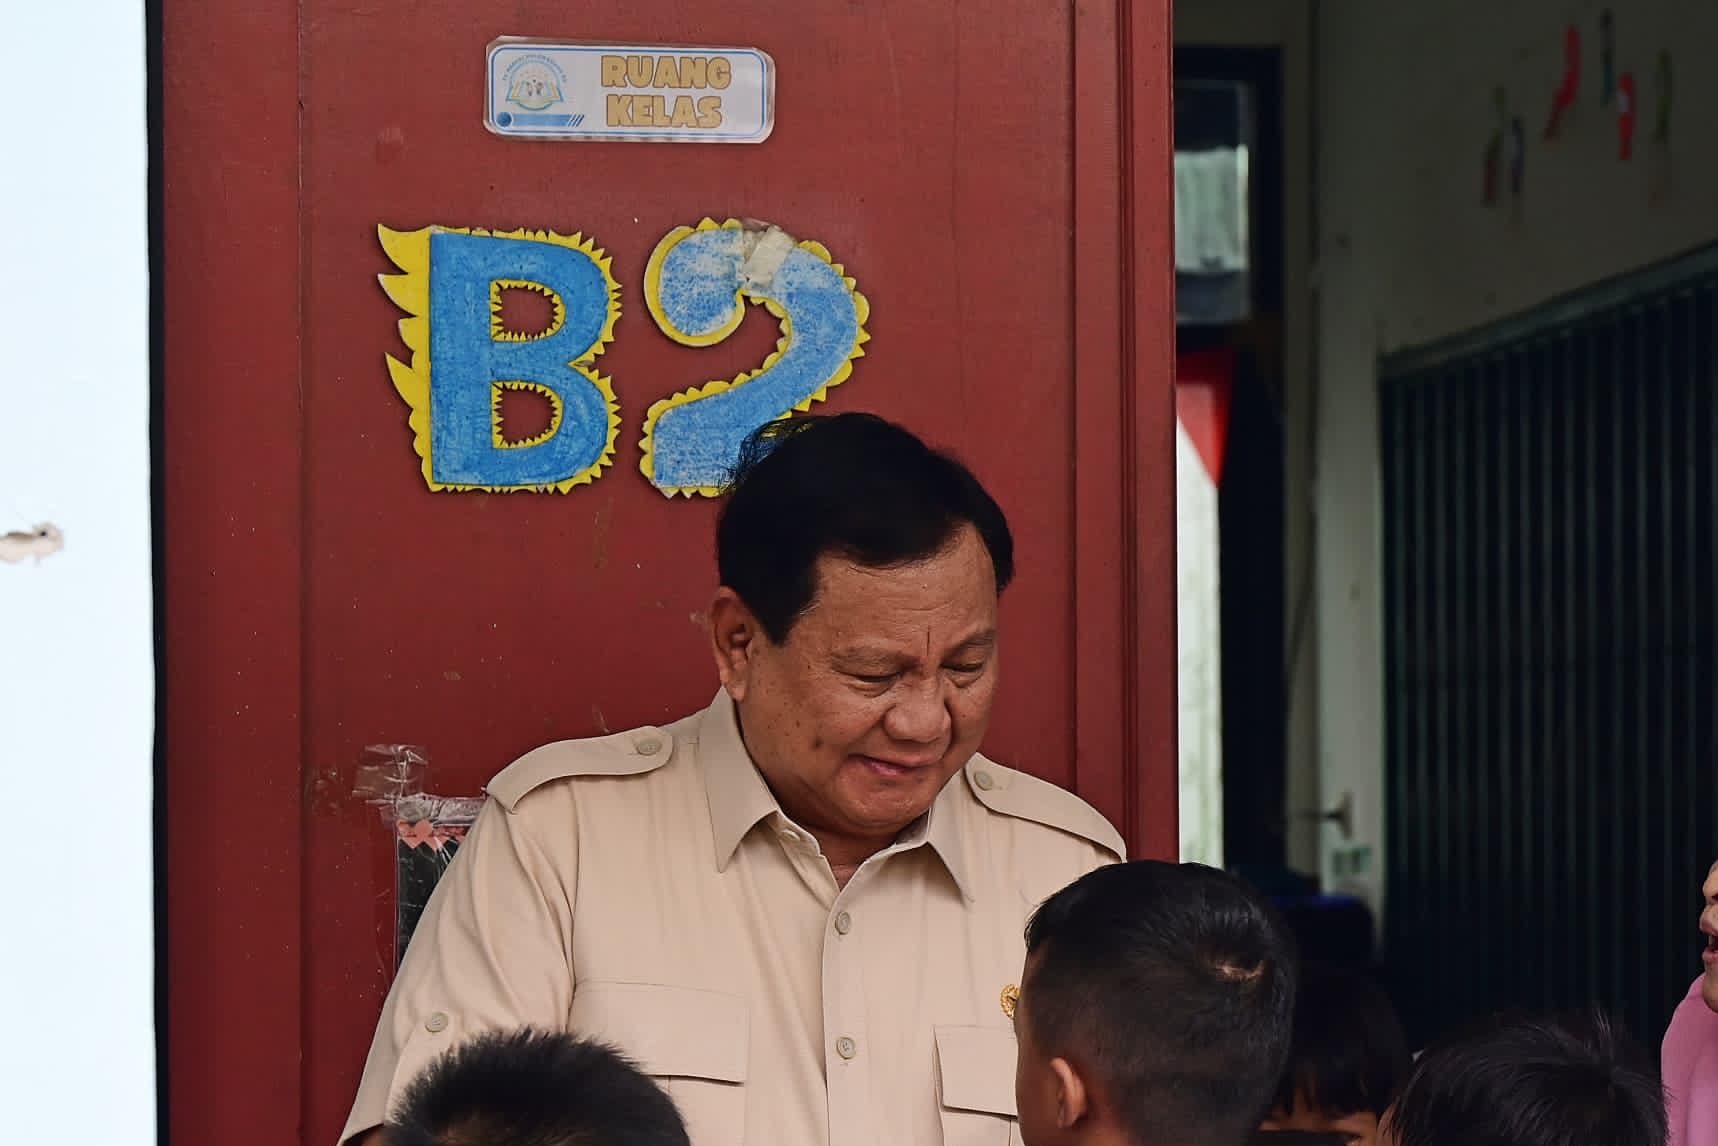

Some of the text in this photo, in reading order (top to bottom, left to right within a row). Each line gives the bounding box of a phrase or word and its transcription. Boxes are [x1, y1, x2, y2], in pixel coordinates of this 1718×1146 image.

[601, 55, 732, 89] RUANG
[606, 94, 722, 128] KELAS
[378, 217, 870, 498] B2
